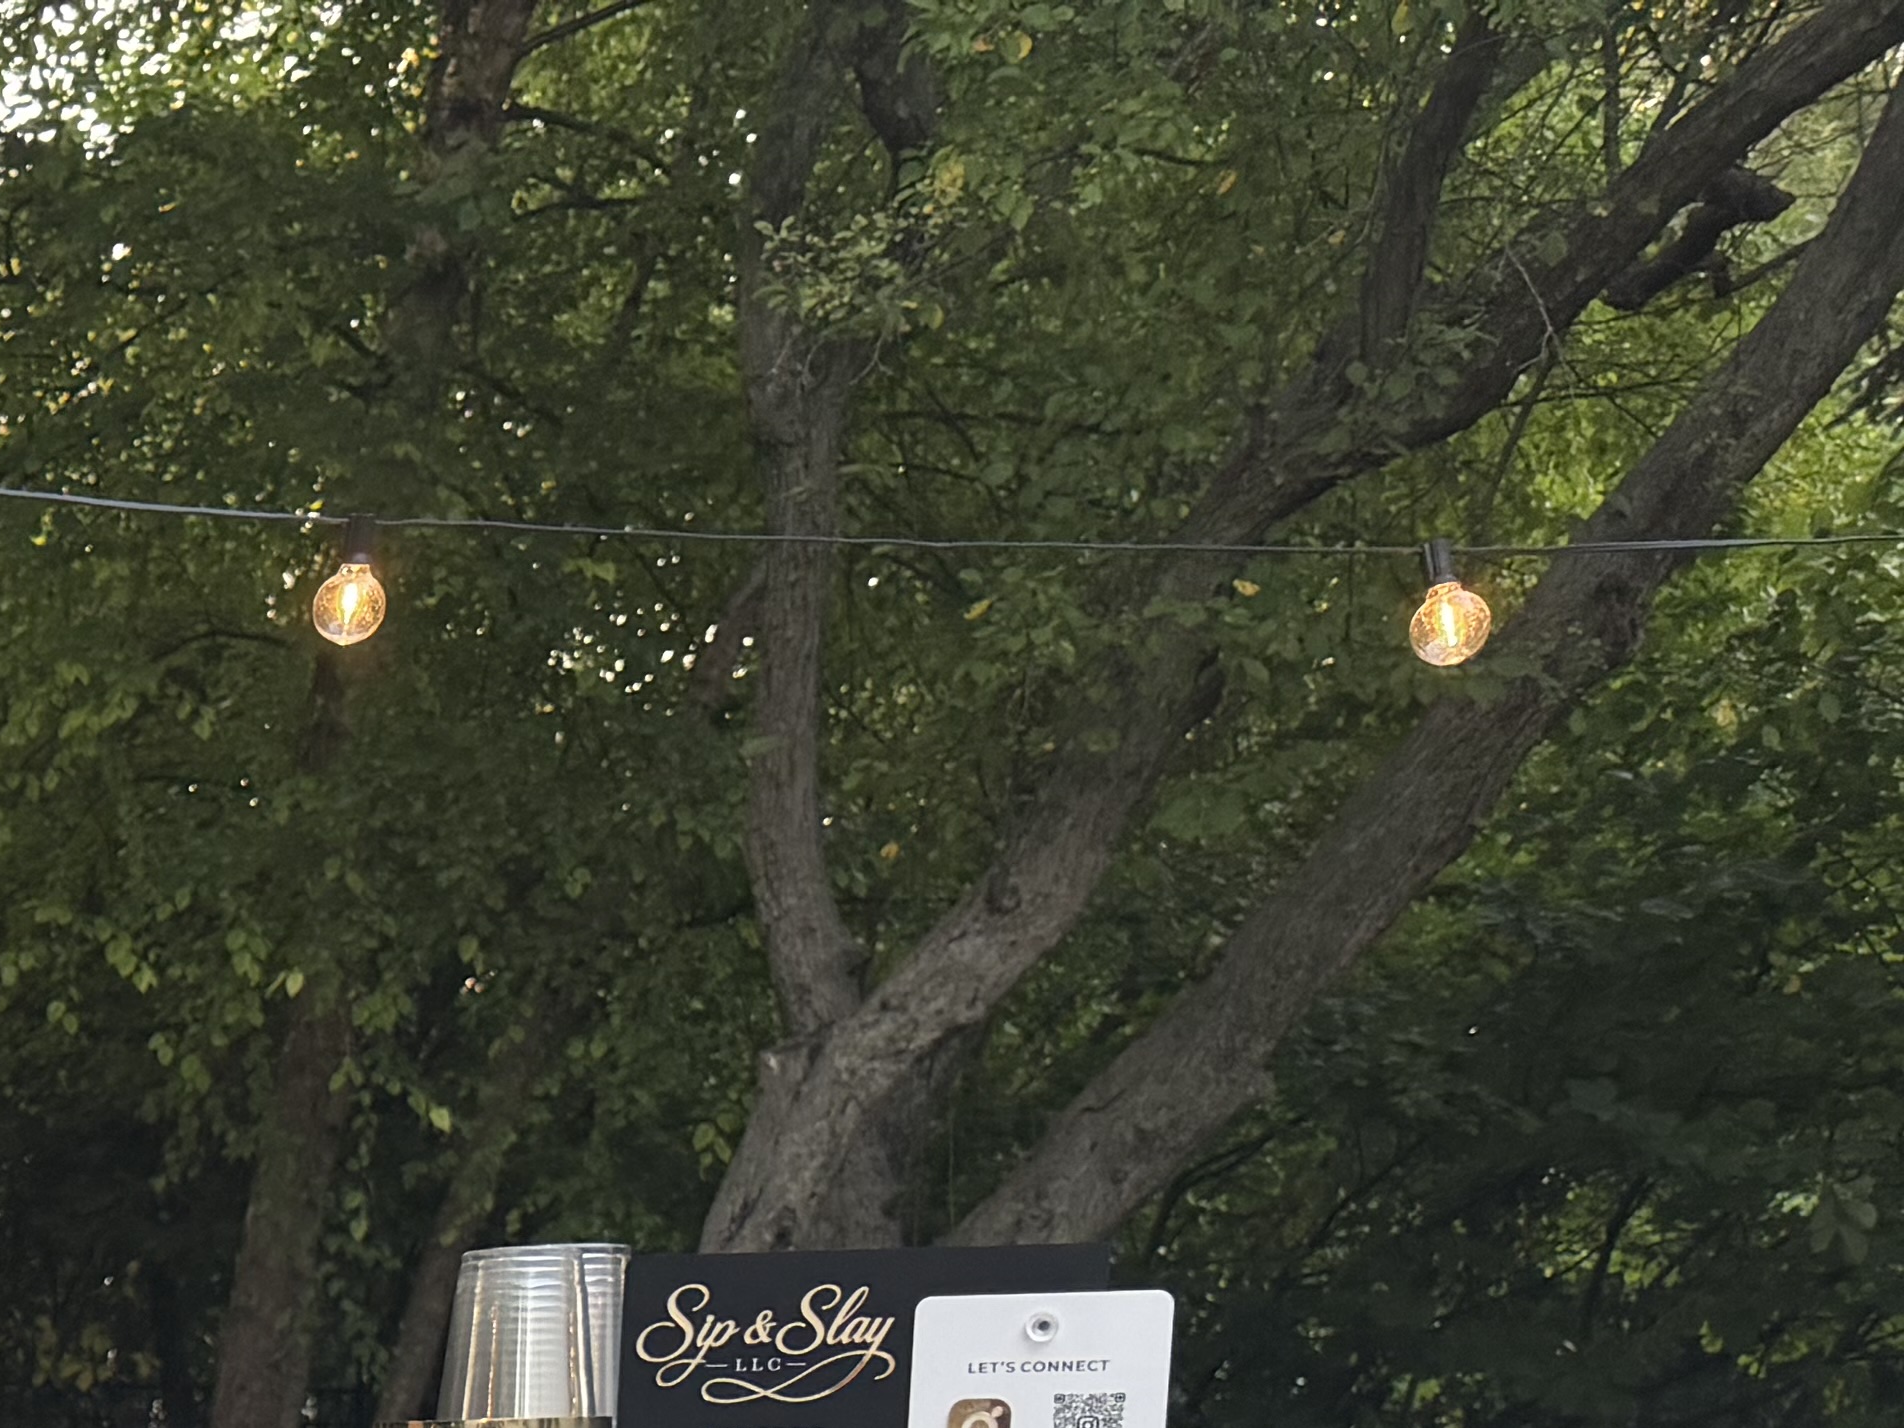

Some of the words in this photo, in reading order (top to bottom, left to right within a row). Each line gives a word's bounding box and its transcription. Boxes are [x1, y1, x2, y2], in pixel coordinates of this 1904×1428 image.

[636, 1284, 740, 1387] Sip
[743, 1310, 777, 1344] &
[775, 1284, 896, 1400] Slay
[735, 1358, 782, 1372] LLC
[968, 1361, 1016, 1374] LET'S
[1020, 1359, 1111, 1373] CONNECT
